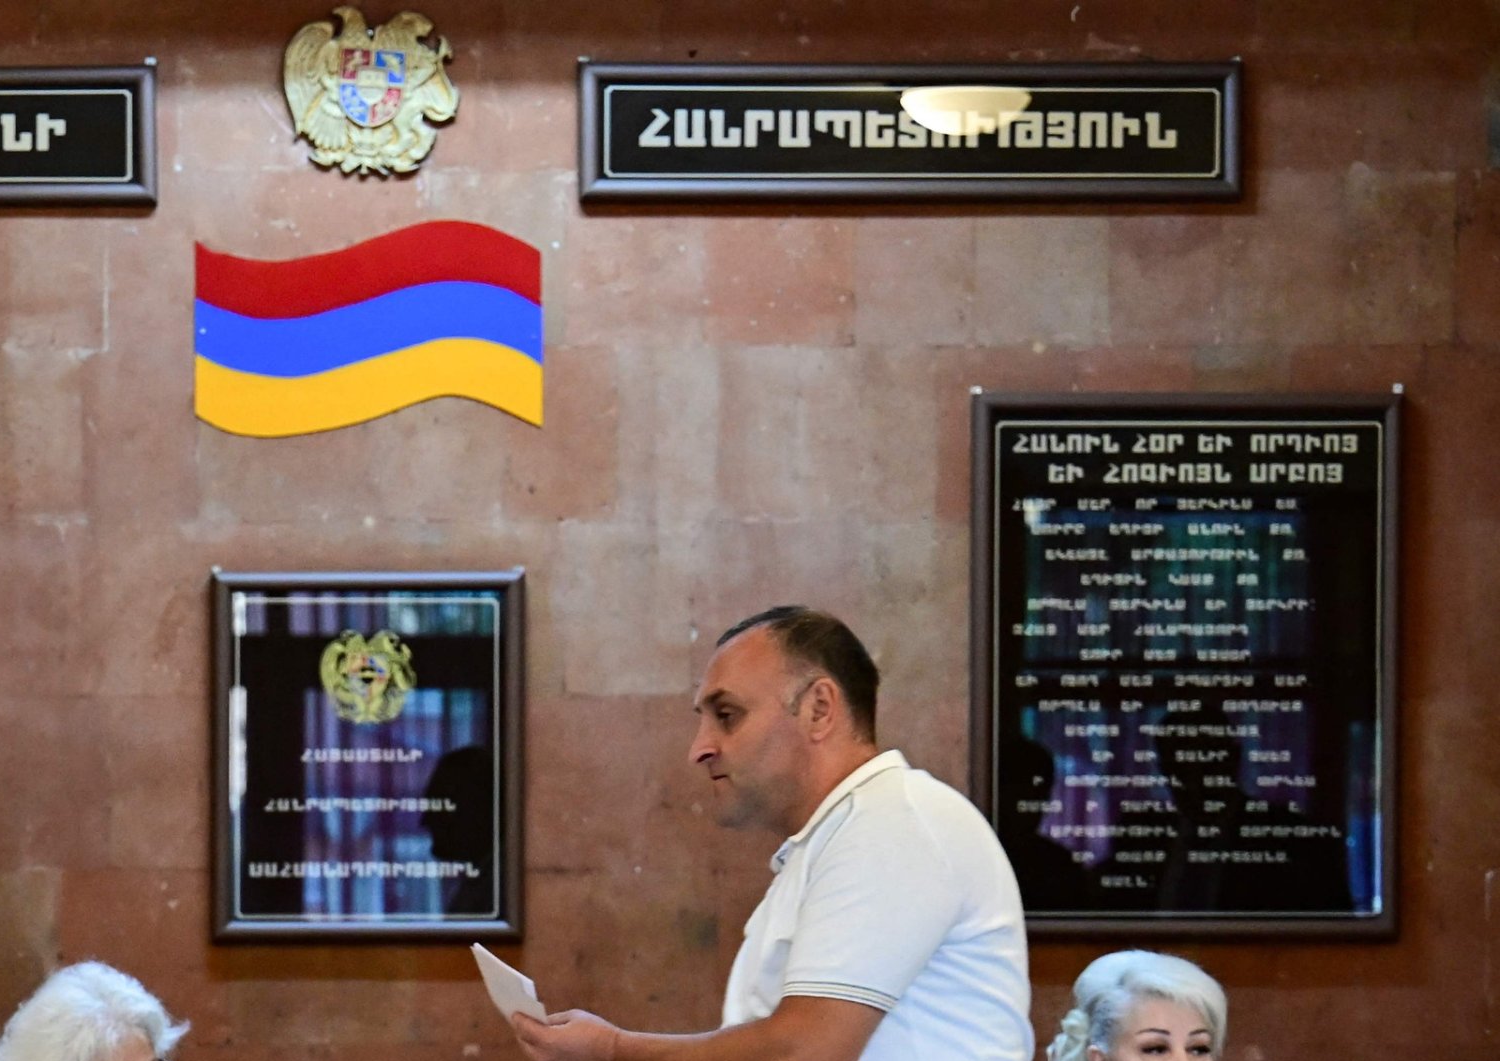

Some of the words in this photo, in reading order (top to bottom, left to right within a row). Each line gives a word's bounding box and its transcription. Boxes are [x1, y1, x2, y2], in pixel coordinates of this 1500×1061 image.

[1012, 434, 1120, 453] ՀԱՆՈՒՆ
[1132, 434, 1184, 453] ՀՕՐ
[1198, 434, 1233, 453] ԵՒ
[1251, 434, 1357, 453] ՈՐԴՒՈՅ
[1048, 463, 1084, 483] ԵՒ
[1103, 463, 1232, 483] ՀՈԳՒՈՅՆ
[1250, 463, 1342, 483] ՍՐԲՈՅ
[301, 748, 423, 763] ՀԱՅԱՍՏԱՆԻ
